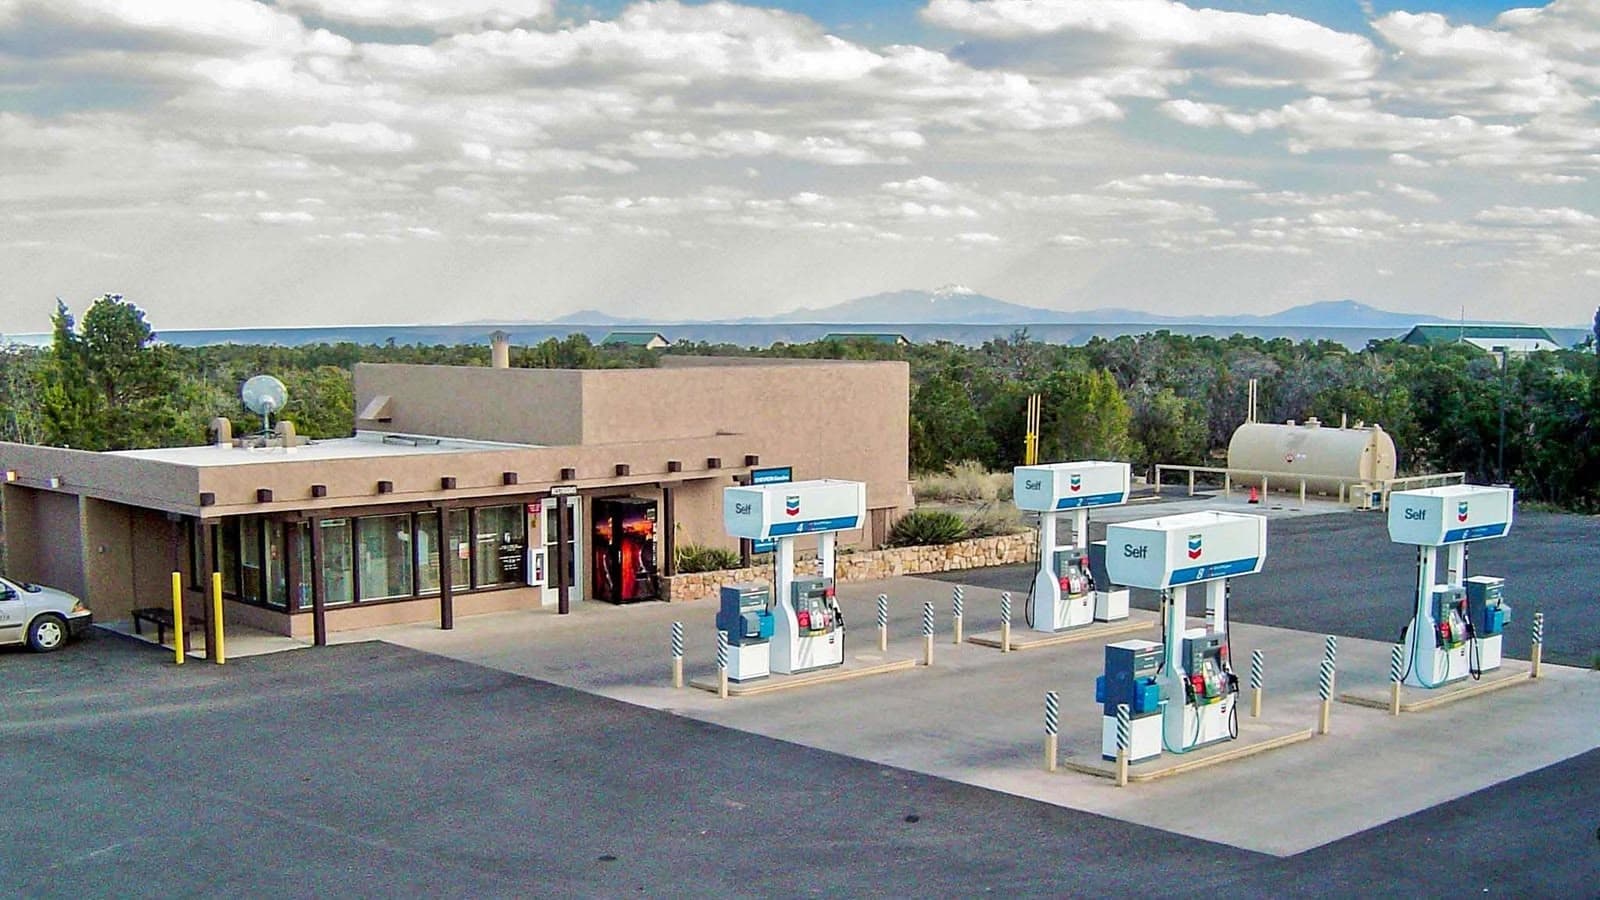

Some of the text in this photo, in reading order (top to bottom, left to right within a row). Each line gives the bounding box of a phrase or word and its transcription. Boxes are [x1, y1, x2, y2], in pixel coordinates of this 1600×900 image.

[1025, 480, 1041, 490] Self
[735, 503, 751, 515] Self
[1404, 508, 1426, 520] Self
[1124, 544, 1148, 559] Self
